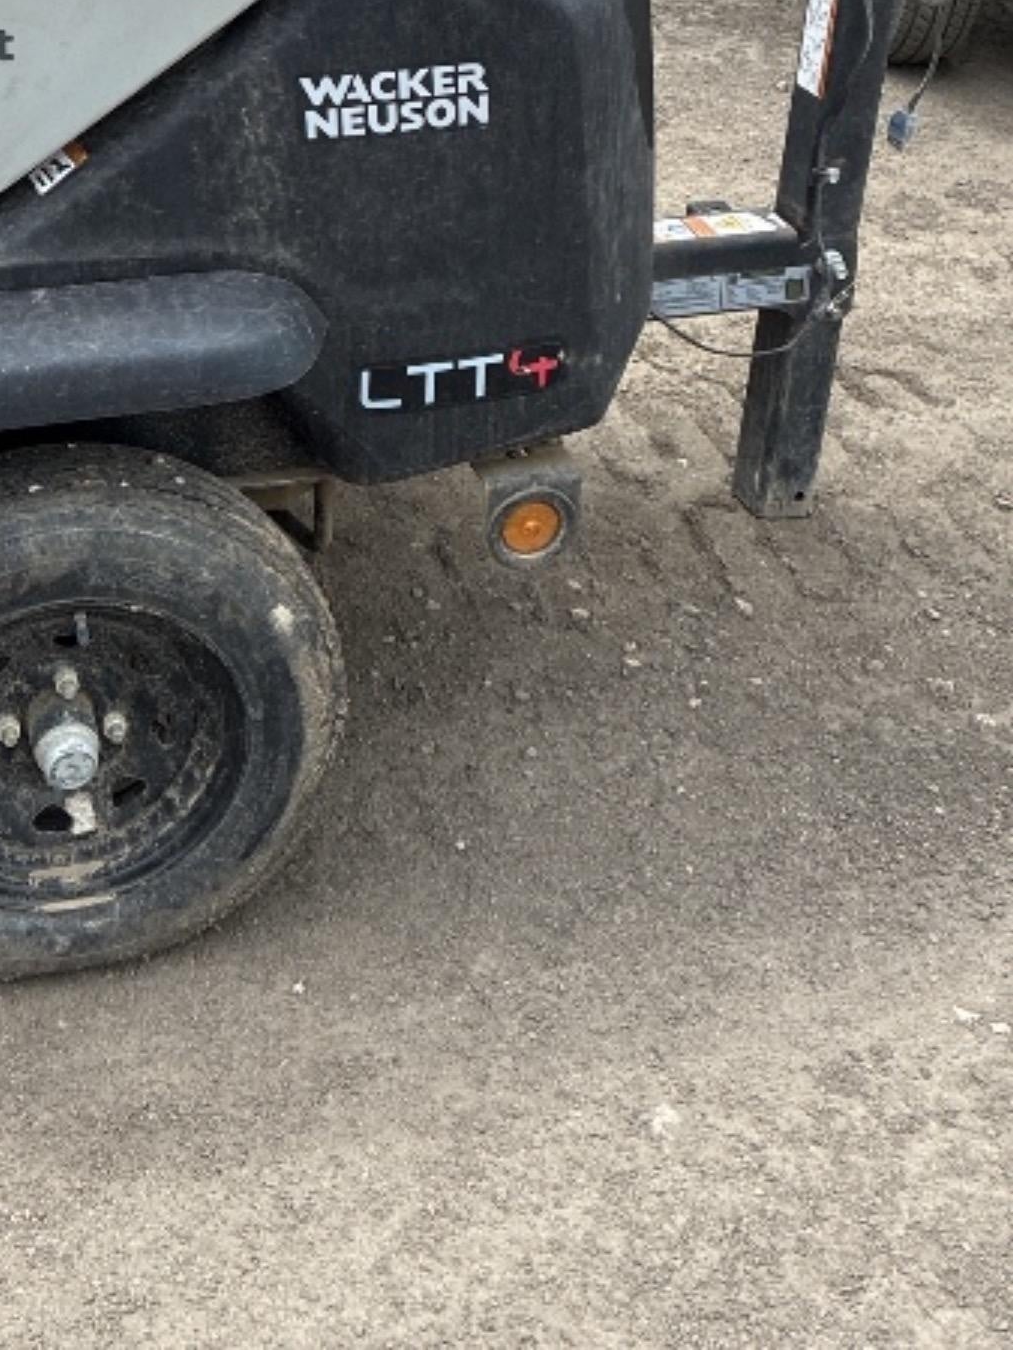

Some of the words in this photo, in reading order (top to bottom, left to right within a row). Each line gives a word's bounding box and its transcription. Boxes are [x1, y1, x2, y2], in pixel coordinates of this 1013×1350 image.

[298, 61, 490, 107] WACKER
[304, 92, 490, 140] NEUSON
[359, 348, 559, 410] LTT4
